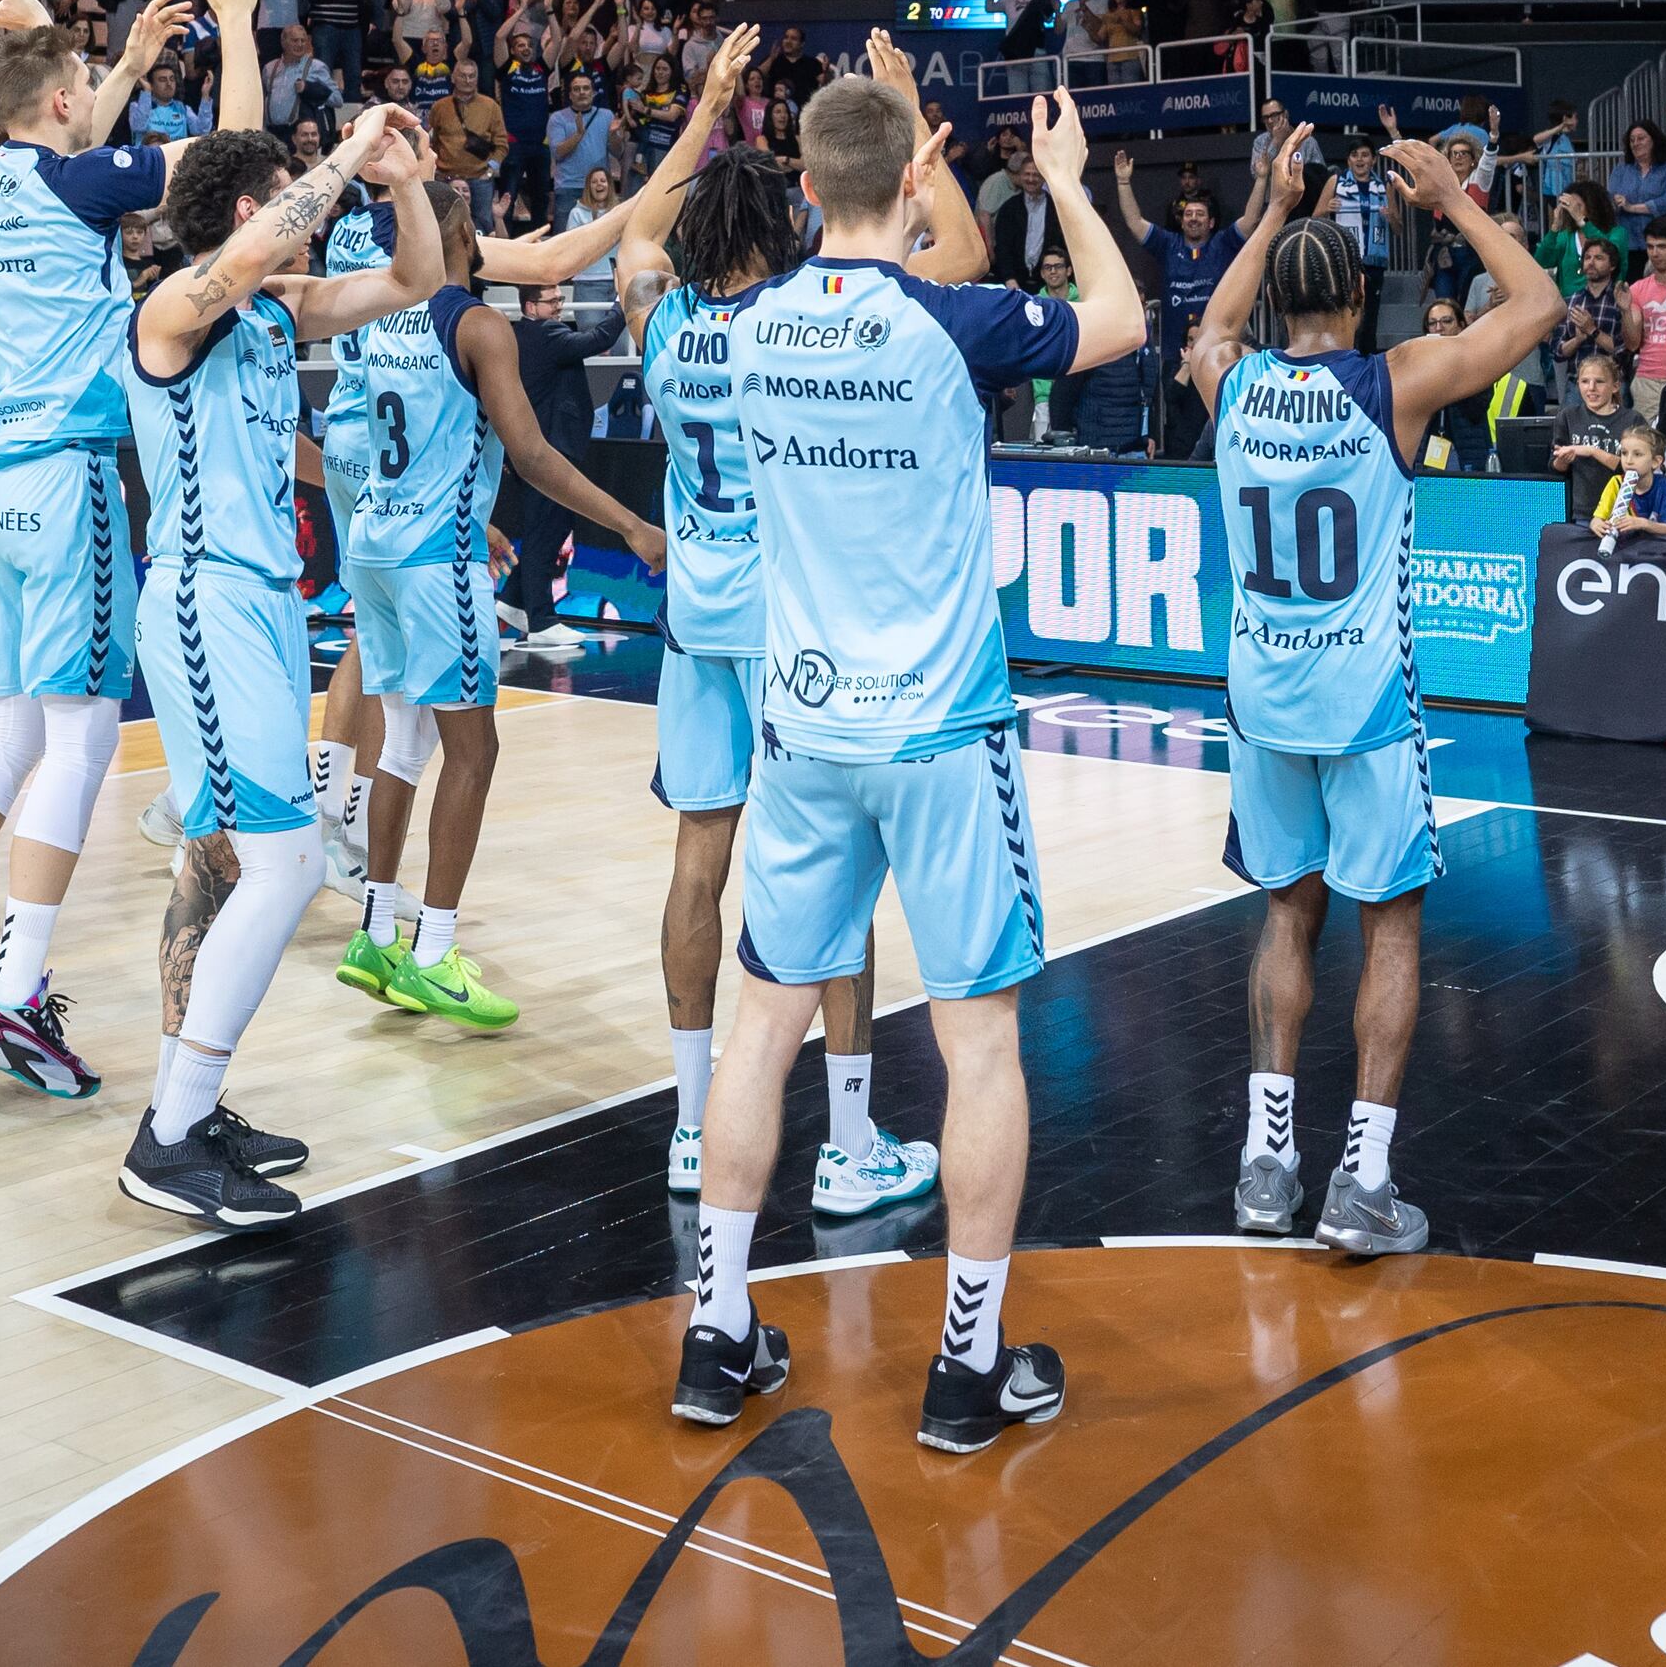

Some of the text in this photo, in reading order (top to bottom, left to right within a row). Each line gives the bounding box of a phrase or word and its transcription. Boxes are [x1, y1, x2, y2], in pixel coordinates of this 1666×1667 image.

[906, 2, 944, 21] 2 TO
[755, 314, 855, 350] unicef
[367, 353, 440, 372] MORABANC
[765, 375, 914, 403] MORABANC
[1242, 383, 1352, 425] HARDING
[376, 389, 411, 480] 3
[1242, 435, 1372, 463] MORABANC
[782, 435, 920, 471] Andorra
[1238, 485, 1360, 603] 10
[1252, 621, 1366, 652] Andorra
[855, 670, 925, 691] SOLUTION
[899, 691, 925, 701] COM
